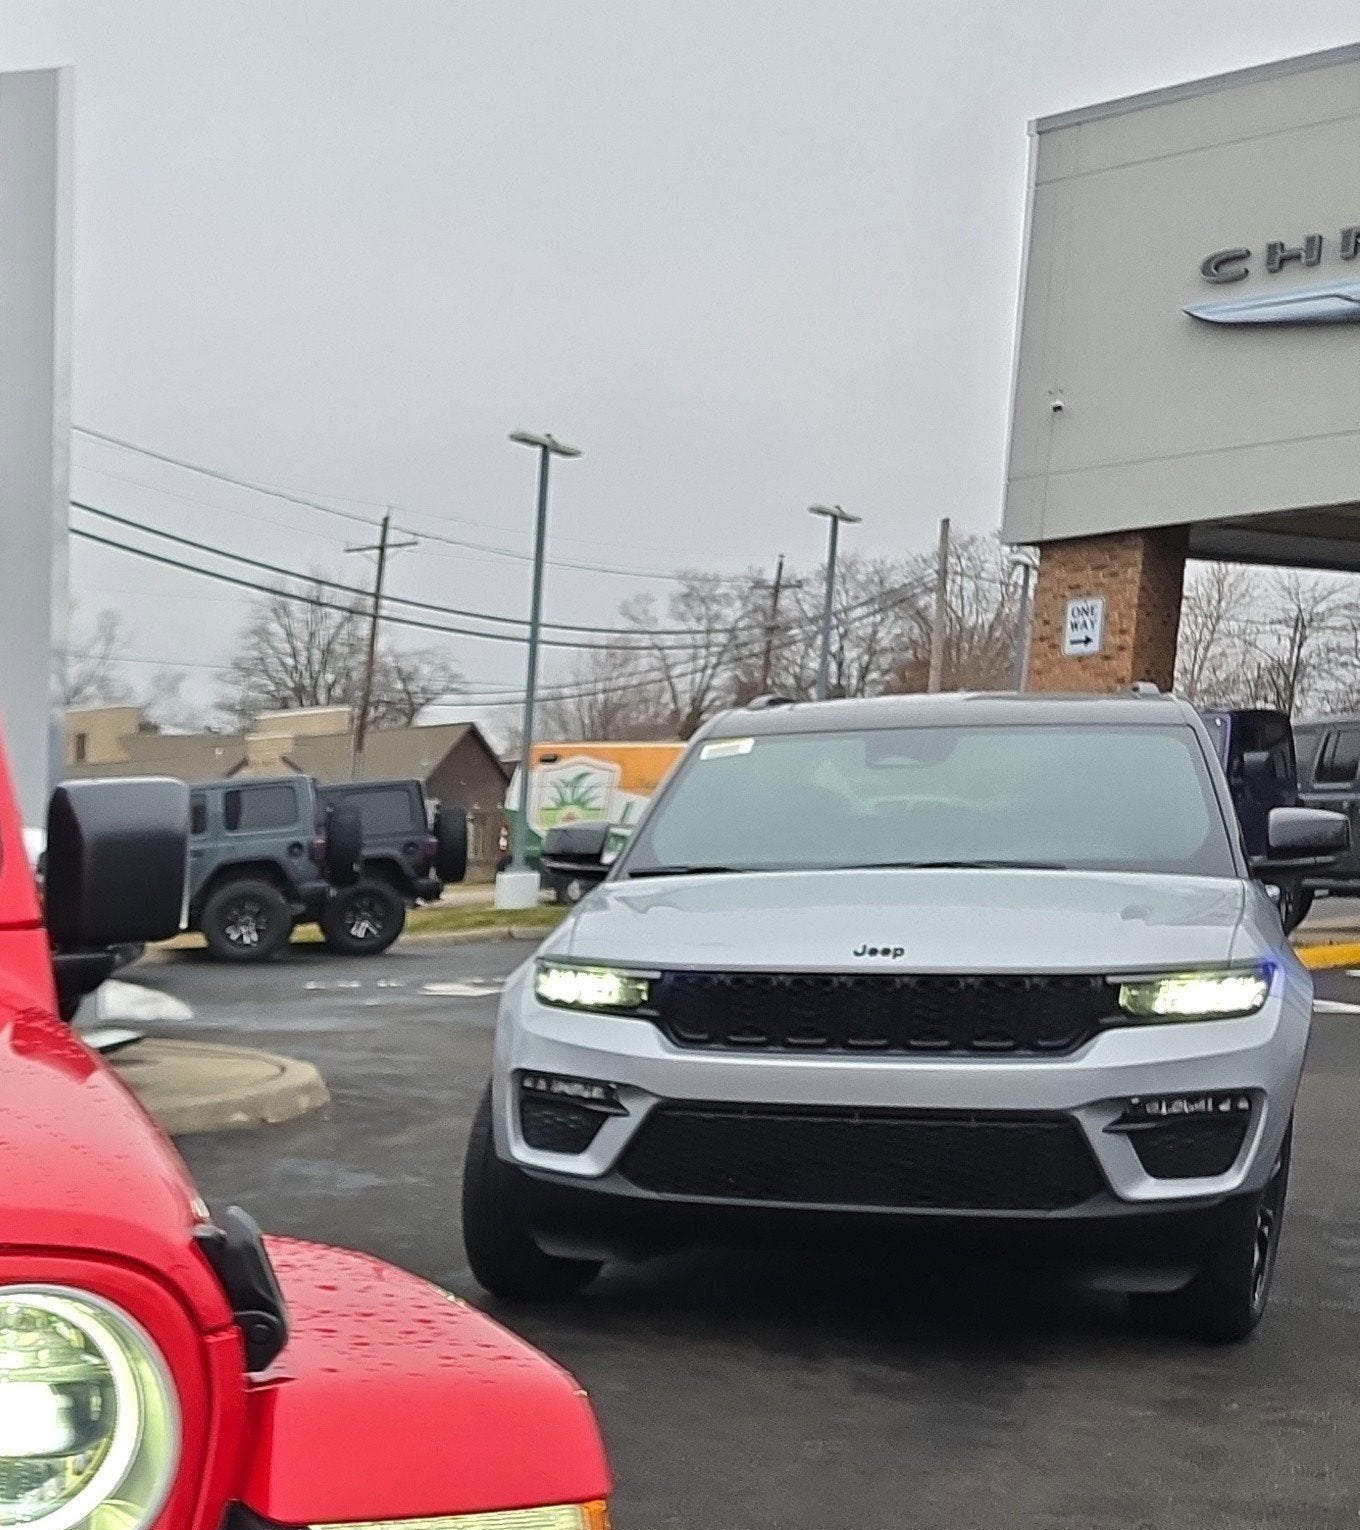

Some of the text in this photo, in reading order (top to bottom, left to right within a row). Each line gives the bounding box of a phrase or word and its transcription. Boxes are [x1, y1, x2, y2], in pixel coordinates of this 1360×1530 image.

[1071, 603, 1096, 618] ONE
[1069, 620, 1095, 632] WAY
[853, 944, 905, 959] Jeep
